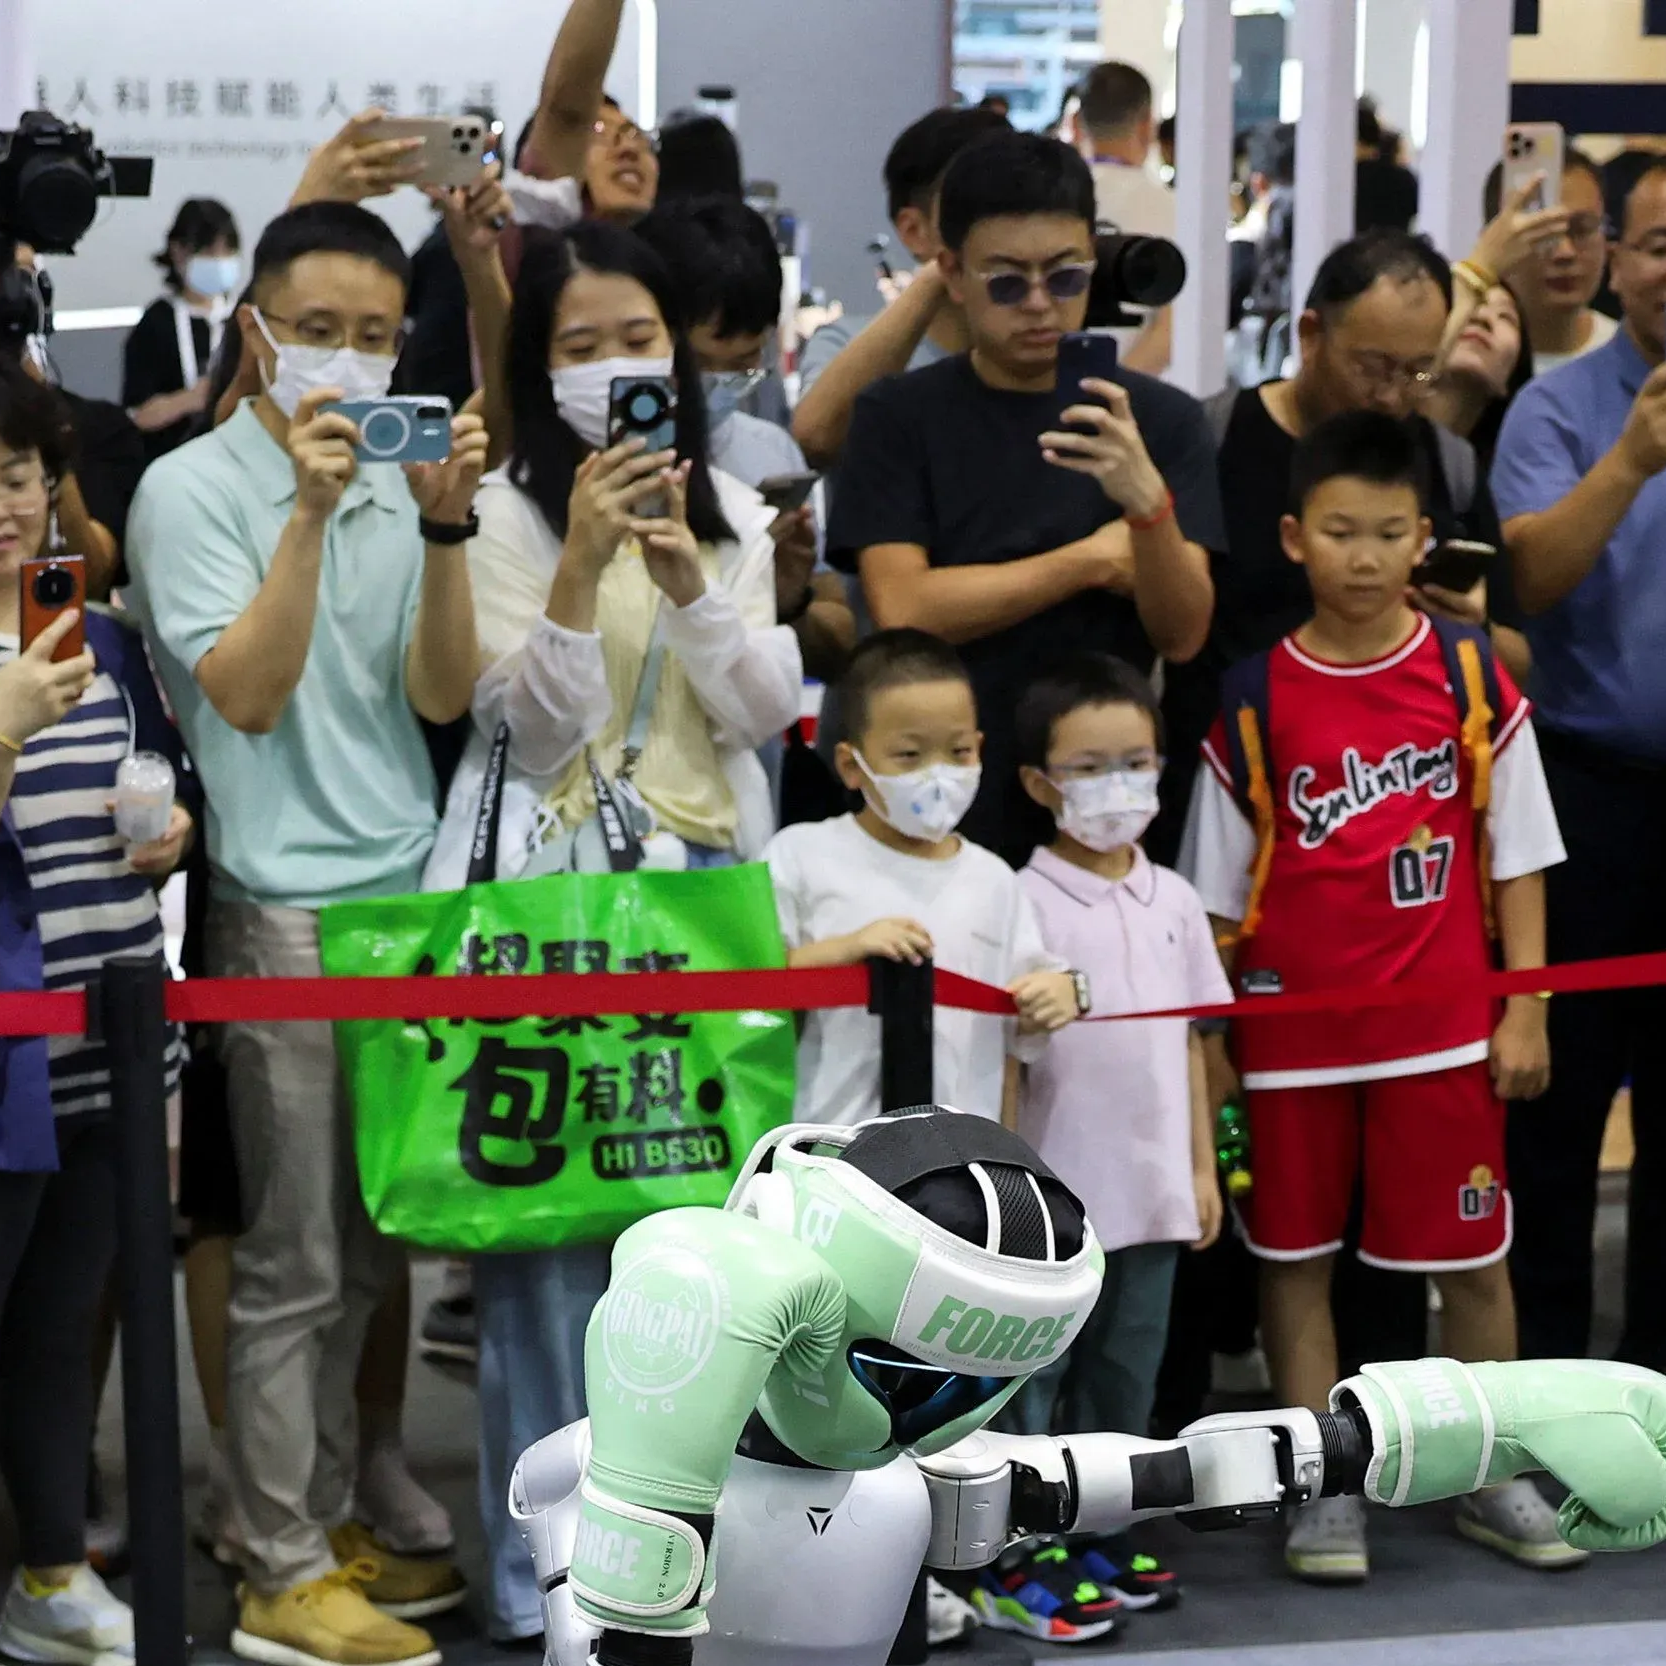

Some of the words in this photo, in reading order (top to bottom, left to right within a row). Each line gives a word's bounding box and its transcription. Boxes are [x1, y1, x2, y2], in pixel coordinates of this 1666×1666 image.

[1391, 839, 1453, 906] 07
[917, 1294, 1077, 1363] FORCE
[575, 1517, 643, 1580] ORCE
[661, 1534, 675, 1578] VERSION
[657, 1582, 667, 1598] 2.0
